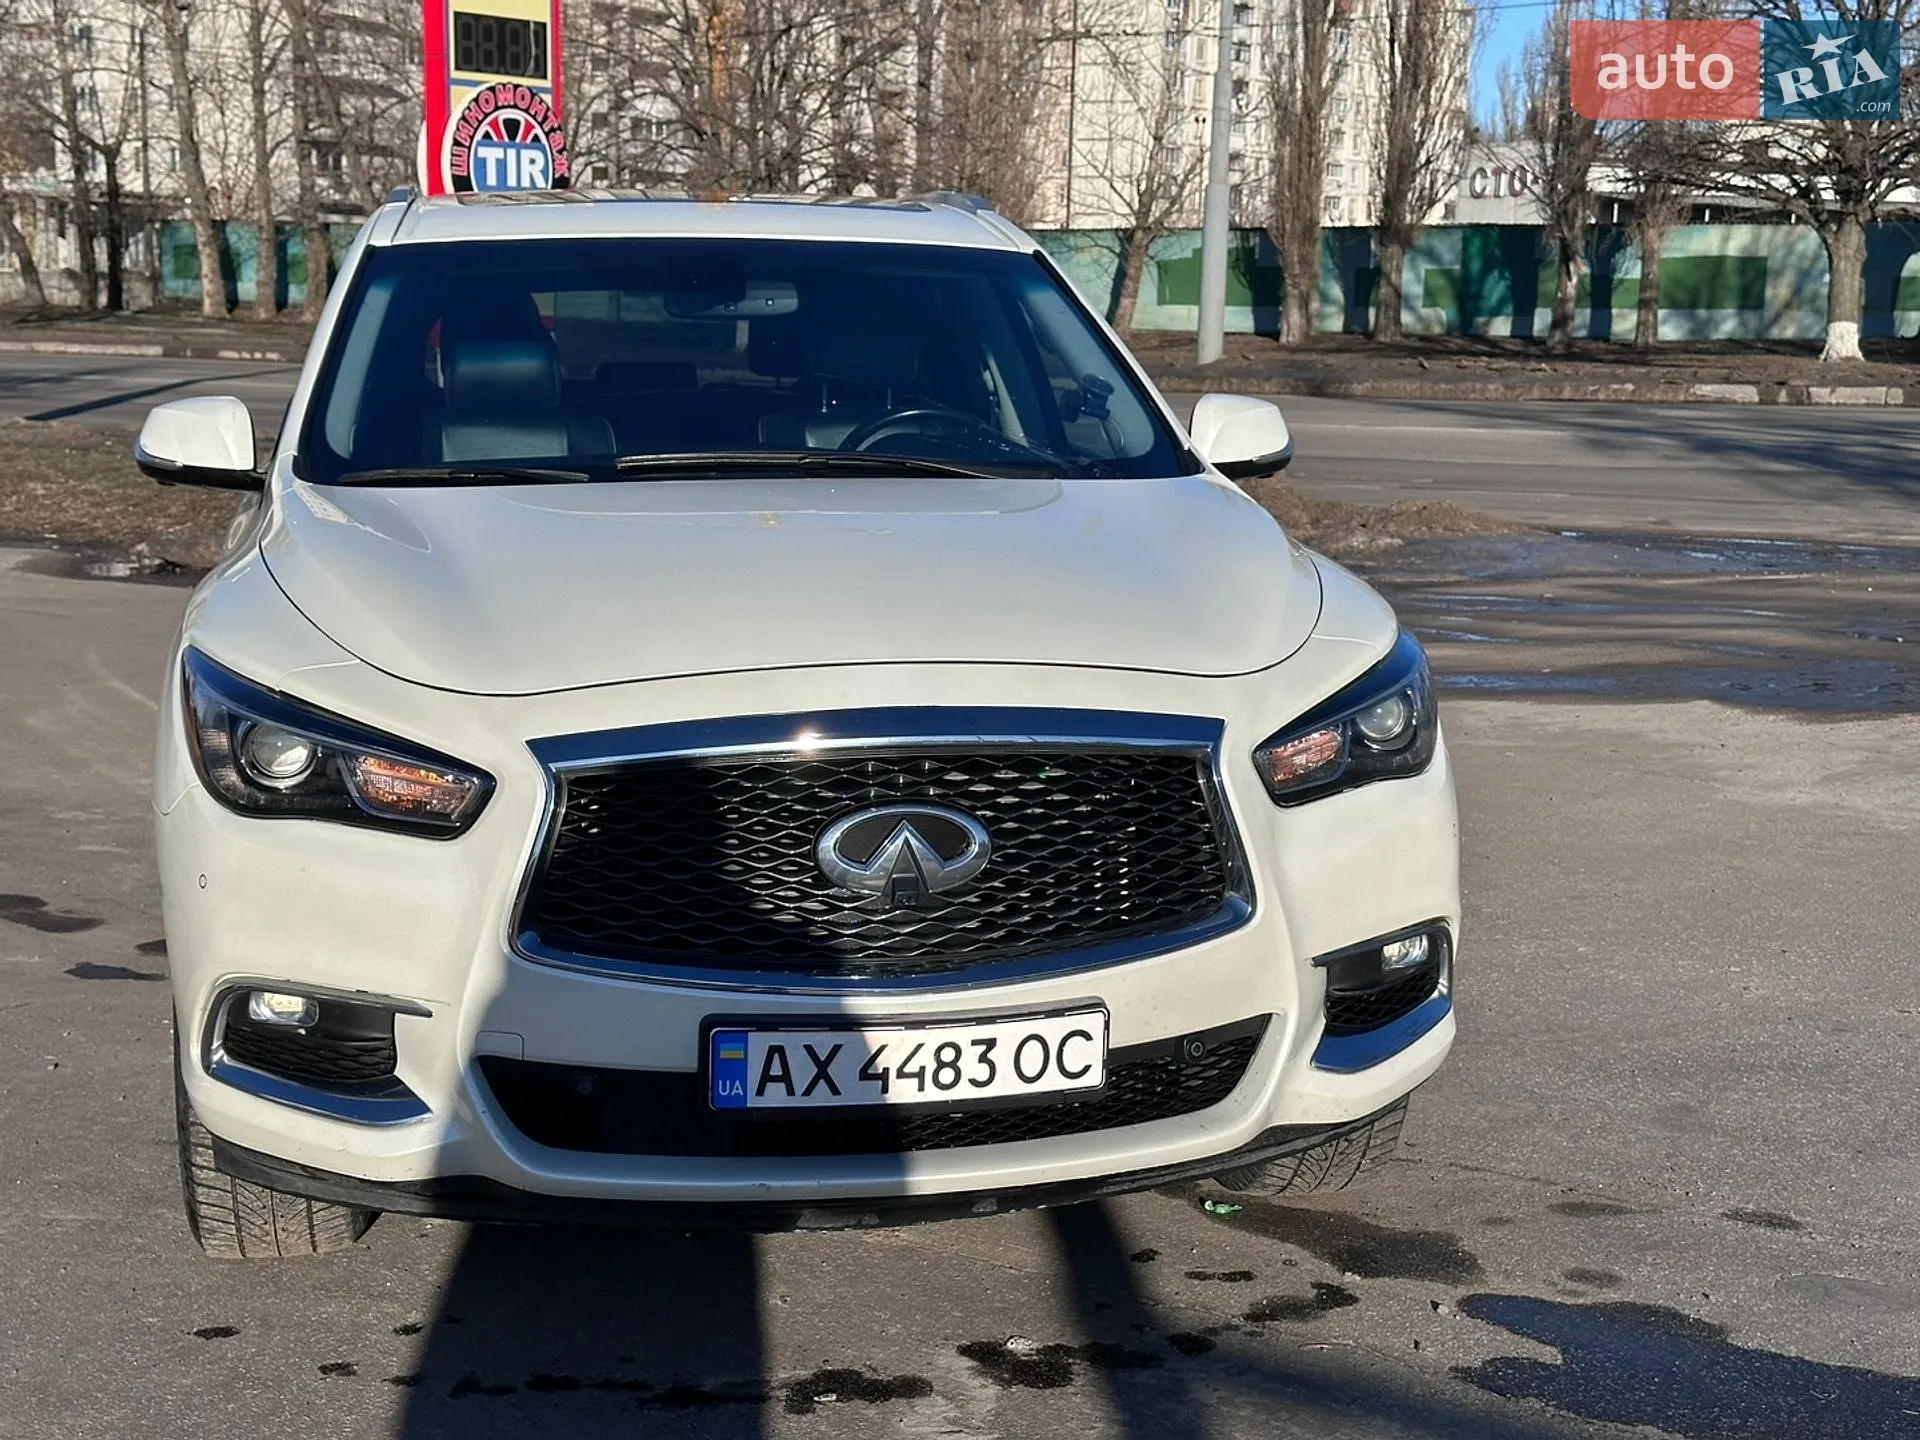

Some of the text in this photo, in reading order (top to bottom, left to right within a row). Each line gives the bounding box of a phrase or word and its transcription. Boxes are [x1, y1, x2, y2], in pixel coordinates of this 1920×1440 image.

[477, 148, 547, 189] TIR
[754, 1029, 1094, 1097] AX 4483 OC
[718, 1083, 744, 1097] UA
